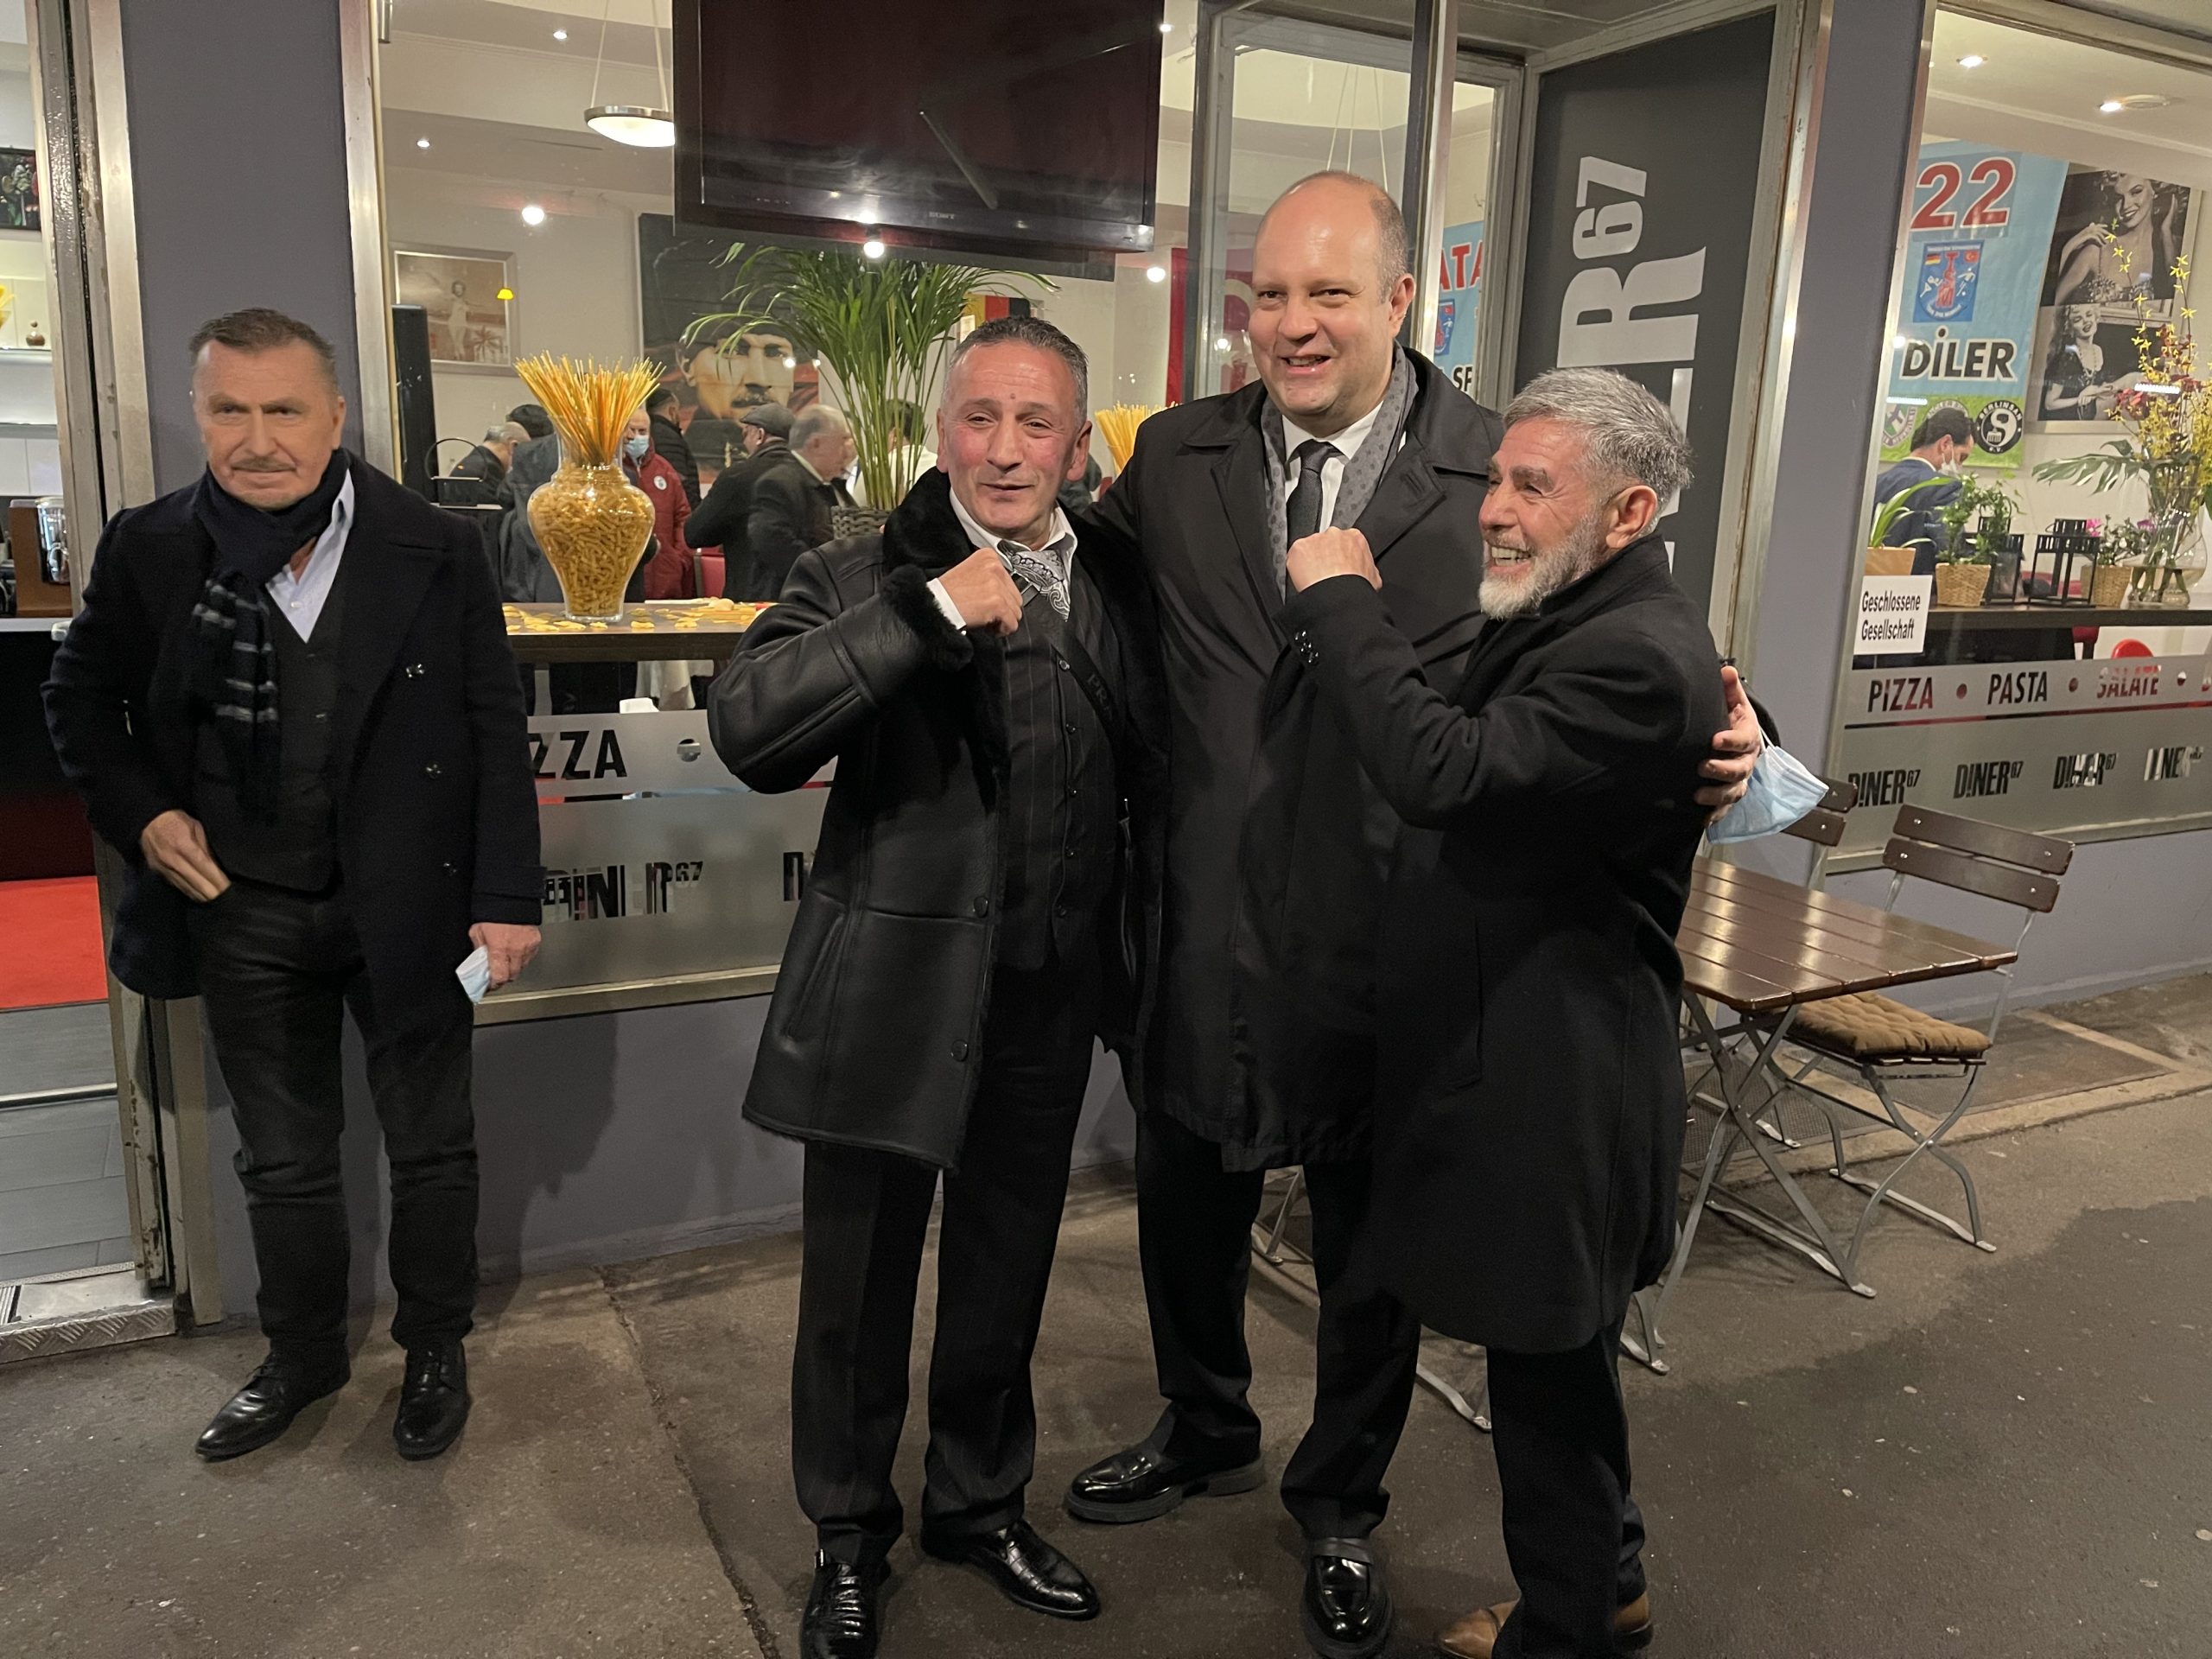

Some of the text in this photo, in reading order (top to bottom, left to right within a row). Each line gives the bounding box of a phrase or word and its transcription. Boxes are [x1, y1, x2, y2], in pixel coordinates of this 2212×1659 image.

[1910, 156, 2016, 232] 22
[1861, 589, 1921, 612] Geschlossene
[1860, 618, 1915, 640] Gesellschaft
[1867, 677, 1934, 713] PIZZA
[1986, 671, 2048, 706] PASTA
